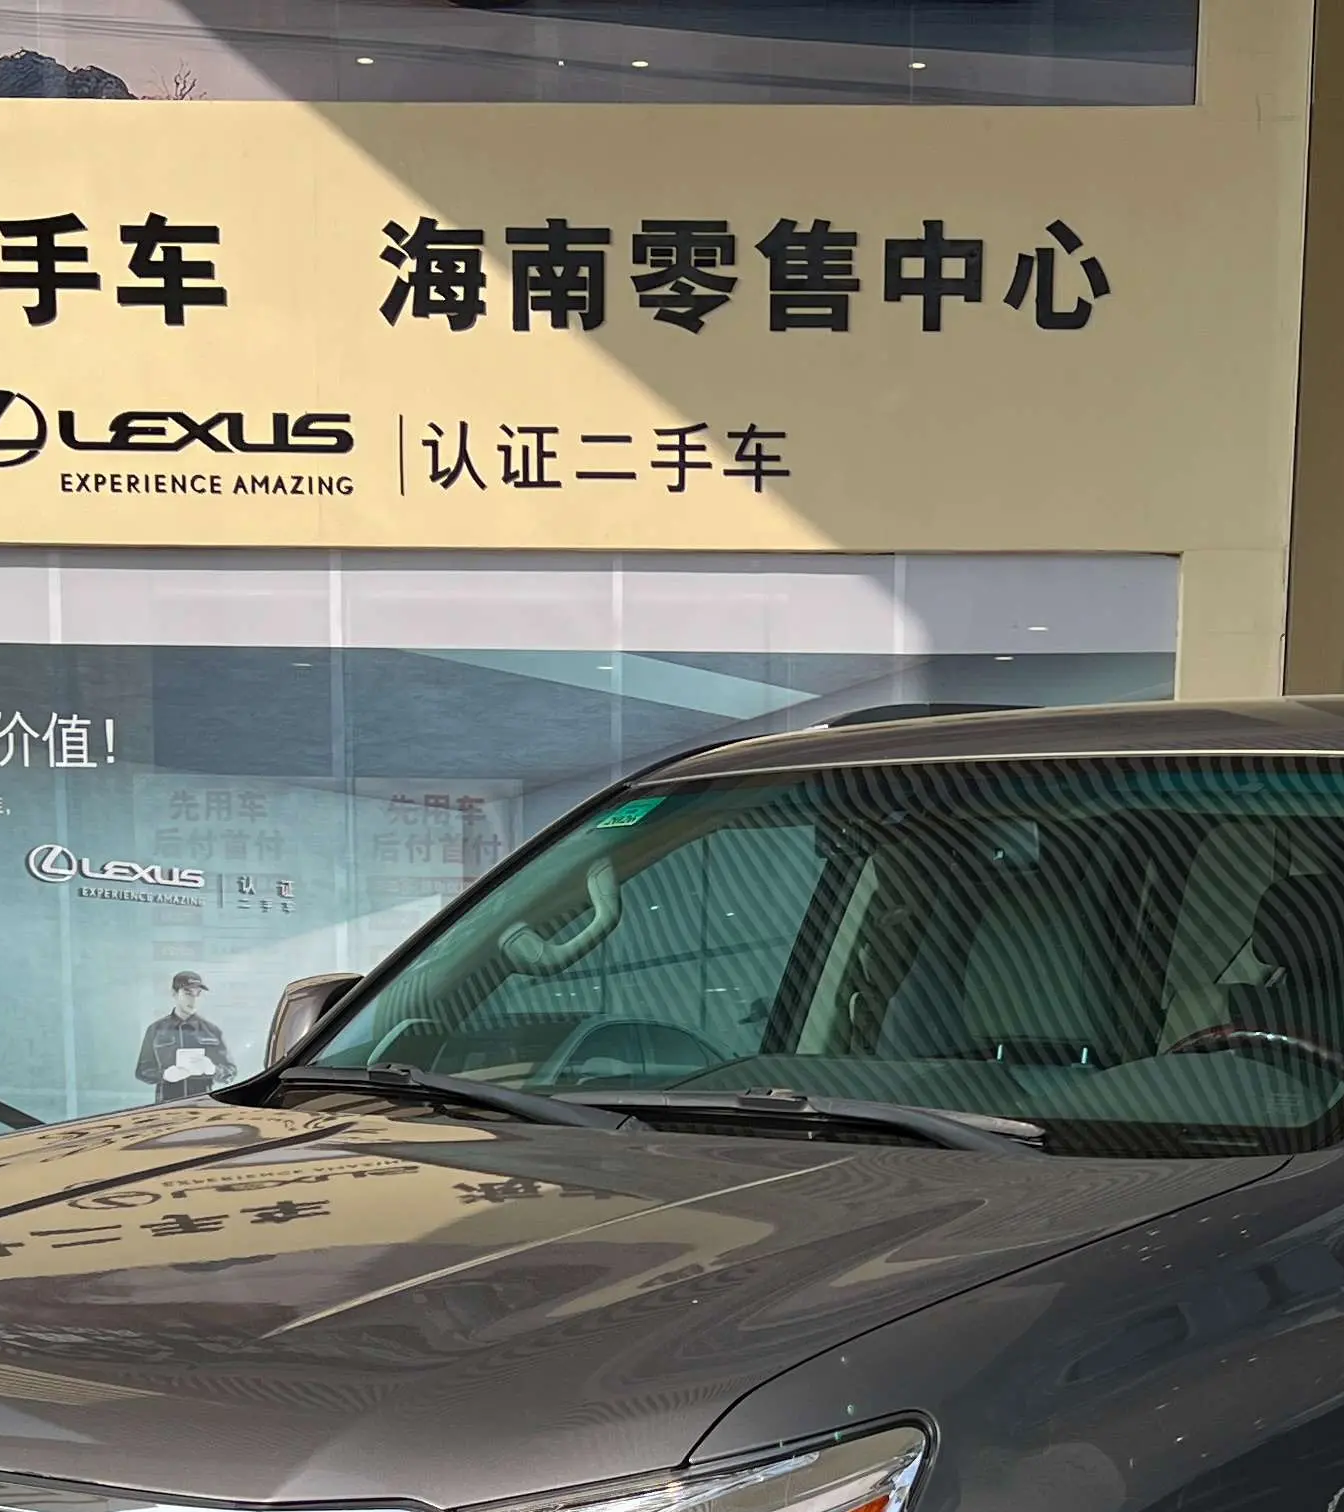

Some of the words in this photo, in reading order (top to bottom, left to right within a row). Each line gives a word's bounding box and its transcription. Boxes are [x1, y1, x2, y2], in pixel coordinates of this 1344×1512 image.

[379, 216, 1111, 336] 海南零售中心
[58, 410, 354, 455] LEXUS
[421, 421, 791, 495] 认证二手车
[60, 473, 223, 495] EXPERIENCE
[232, 474, 355, 496] AMAZING
[80, 857, 205, 889] LEXUS
[237, 874, 296, 898] 认证
[79, 886, 154, 903] EXPERIENCE
